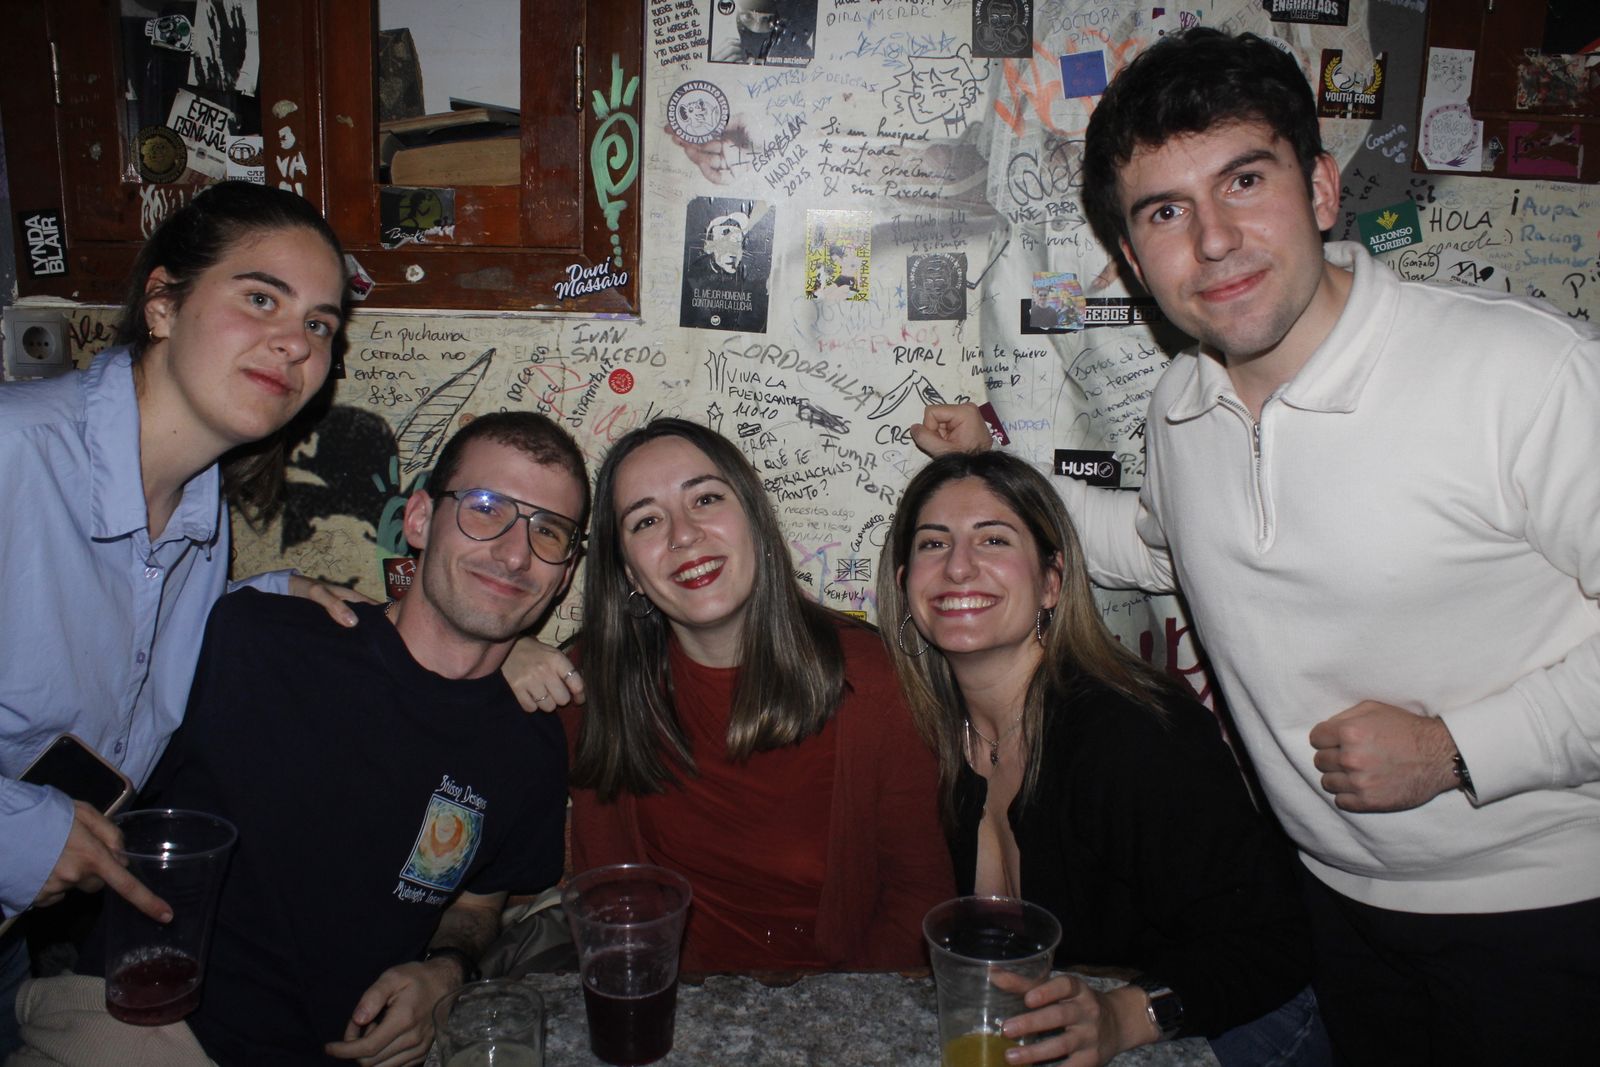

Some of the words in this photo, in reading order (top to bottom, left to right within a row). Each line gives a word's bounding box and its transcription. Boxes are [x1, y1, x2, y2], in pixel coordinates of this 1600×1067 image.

[1048, 7, 1120, 34] DOCTORA
[1070, 27, 1111, 46] PATO
[1325, 92, 1353, 103] YOUTH
[1354, 93, 1376, 104] FANS
[783, 166, 811, 197] 2025
[852, 182, 875, 196] sin
[1522, 196, 1580, 222] Aupa
[1429, 207, 1492, 233] HOLA
[25, 214, 50, 276] LYNDA
[46, 216, 66, 275] BLAIR
[1369, 226, 1413, 246] ALFONSO
[1372, 236, 1412, 254] TORIBIO
[1521, 225, 1583, 252] Racing
[566, 256, 612, 284] Dani
[555, 271, 628, 300] Massaro
[694, 288, 700, 298] EL
[702, 288, 721, 300] MEJOR
[722, 290, 752, 302] HOMENAJE
[692, 298, 724, 310] CONTINUAR
[725, 300, 733, 310] LA
[733, 301, 753, 312] LUCHA
[370, 321, 393, 340] En
[441, 351, 466, 361] no
[570, 346, 667, 367] SALCEDO
[893, 345, 946, 366] RURAL
[994, 347, 1007, 358] te
[1013, 349, 1048, 365] quiero
[354, 366, 416, 380] entran
[726, 368, 761, 384] VIVA
[765, 376, 787, 389] LA
[971, 362, 1010, 377] mucho
[732, 402, 779, 419] 14010
[389, 573, 413, 586] PUEB
